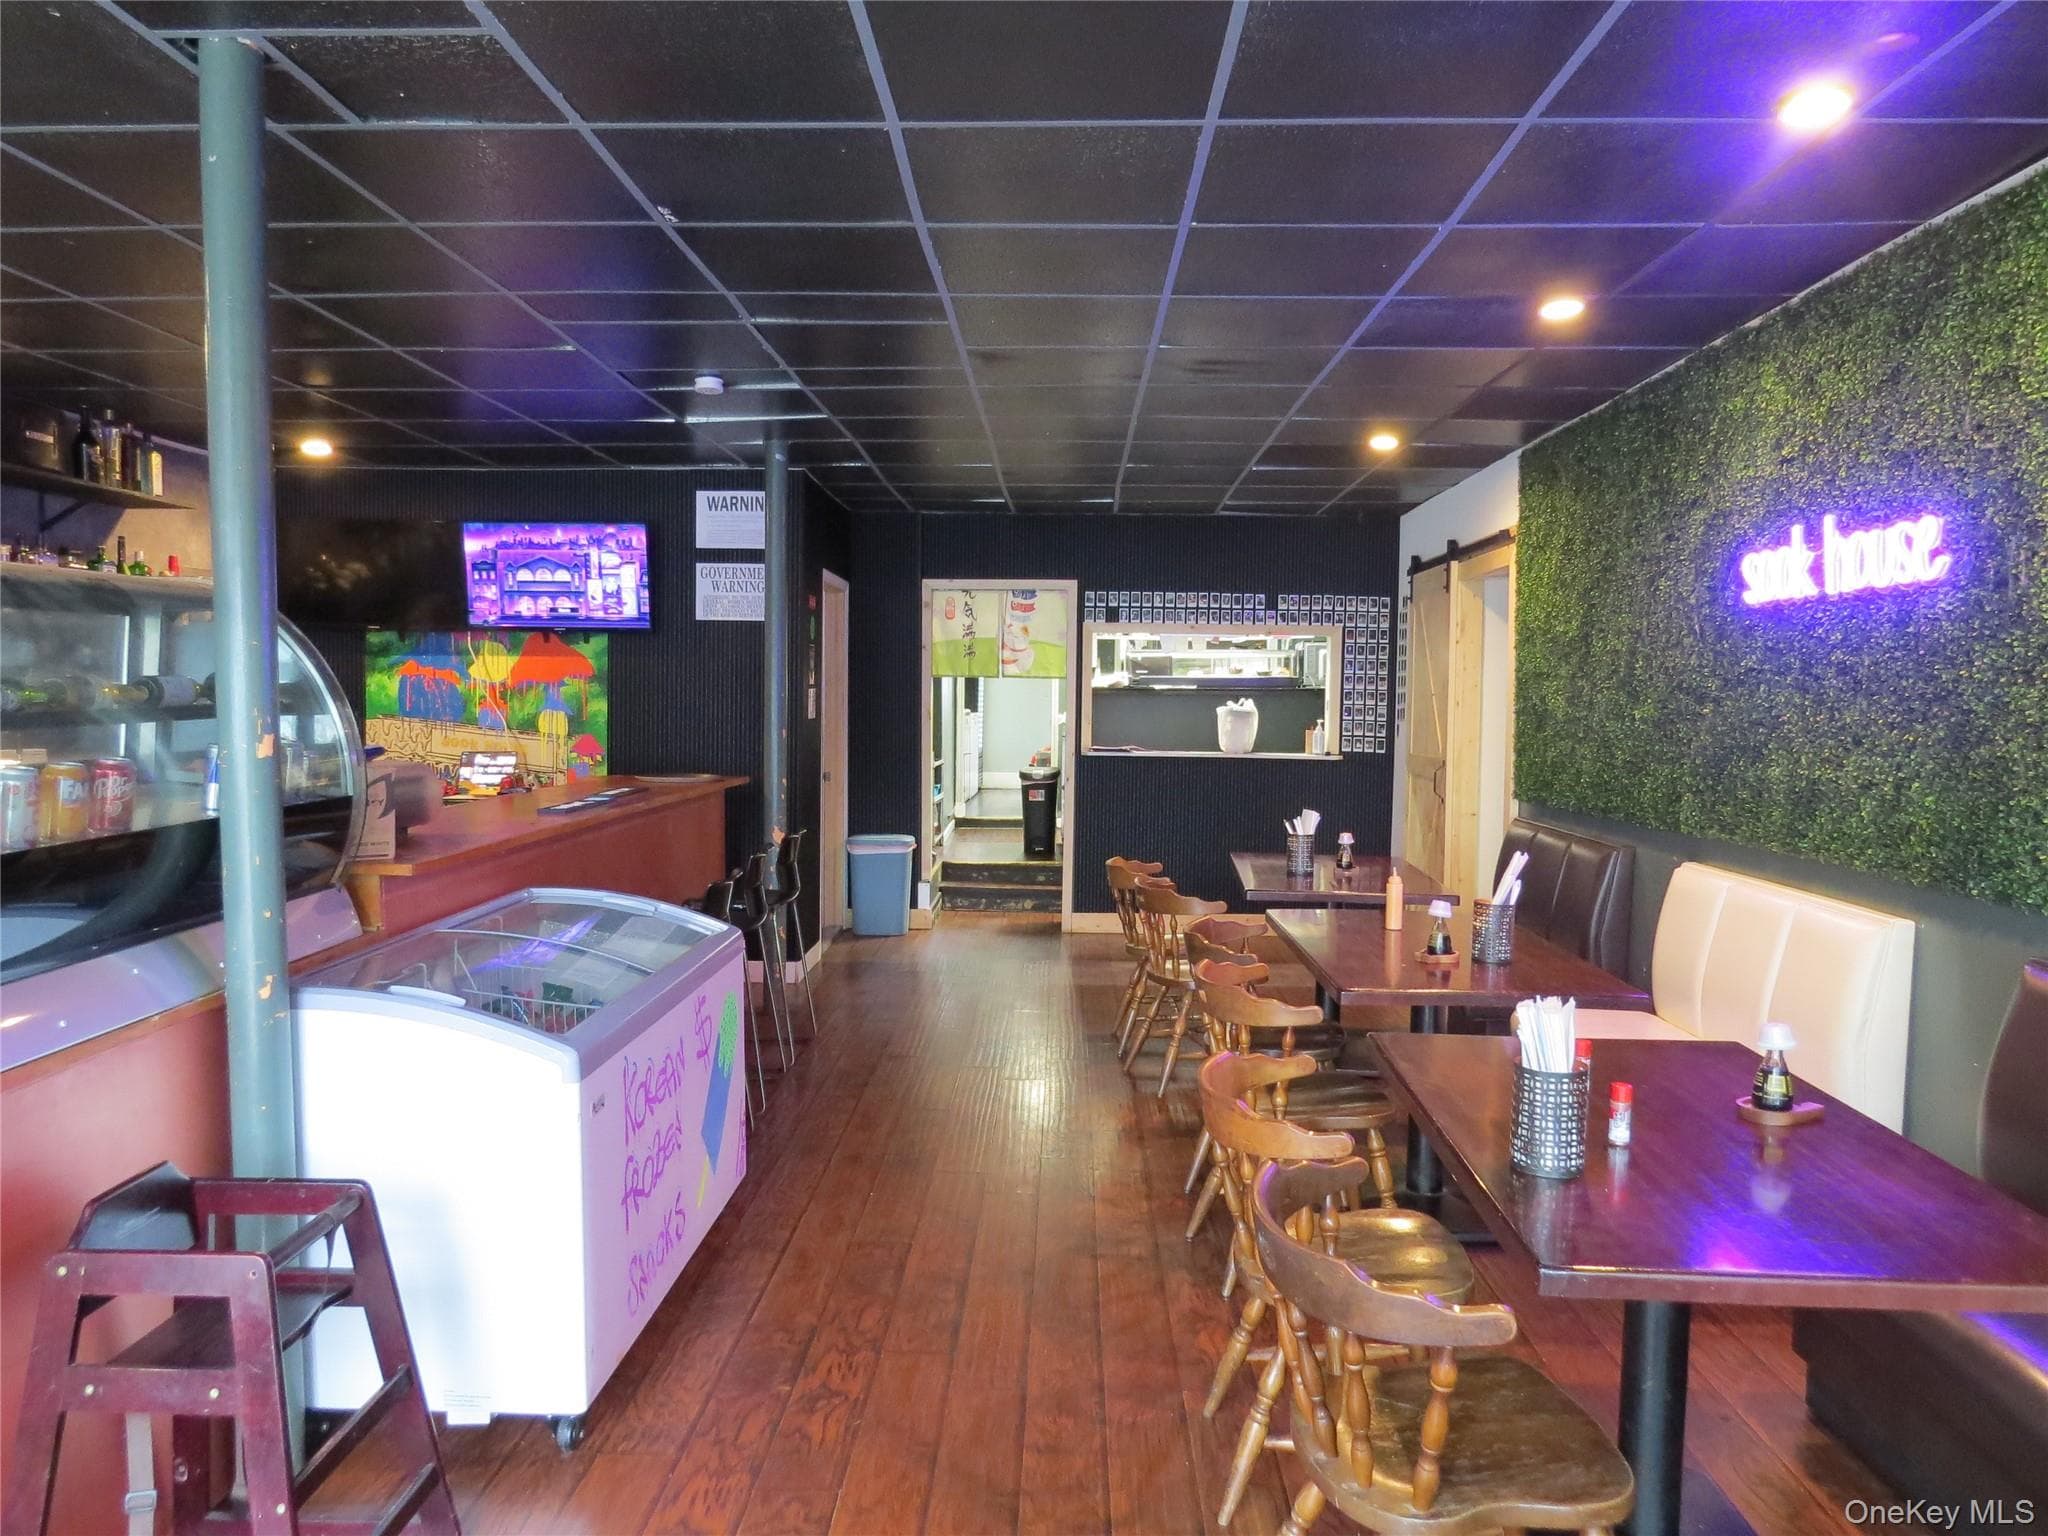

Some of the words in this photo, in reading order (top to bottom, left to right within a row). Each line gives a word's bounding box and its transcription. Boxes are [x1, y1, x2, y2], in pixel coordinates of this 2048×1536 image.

[707, 495, 765, 512] WARNIN
[1823, 514, 1952, 594] house
[700, 566, 765, 580] GOVERNME
[711, 580, 765, 593] WARNING
[623, 1036, 686, 1148] KOREAN
